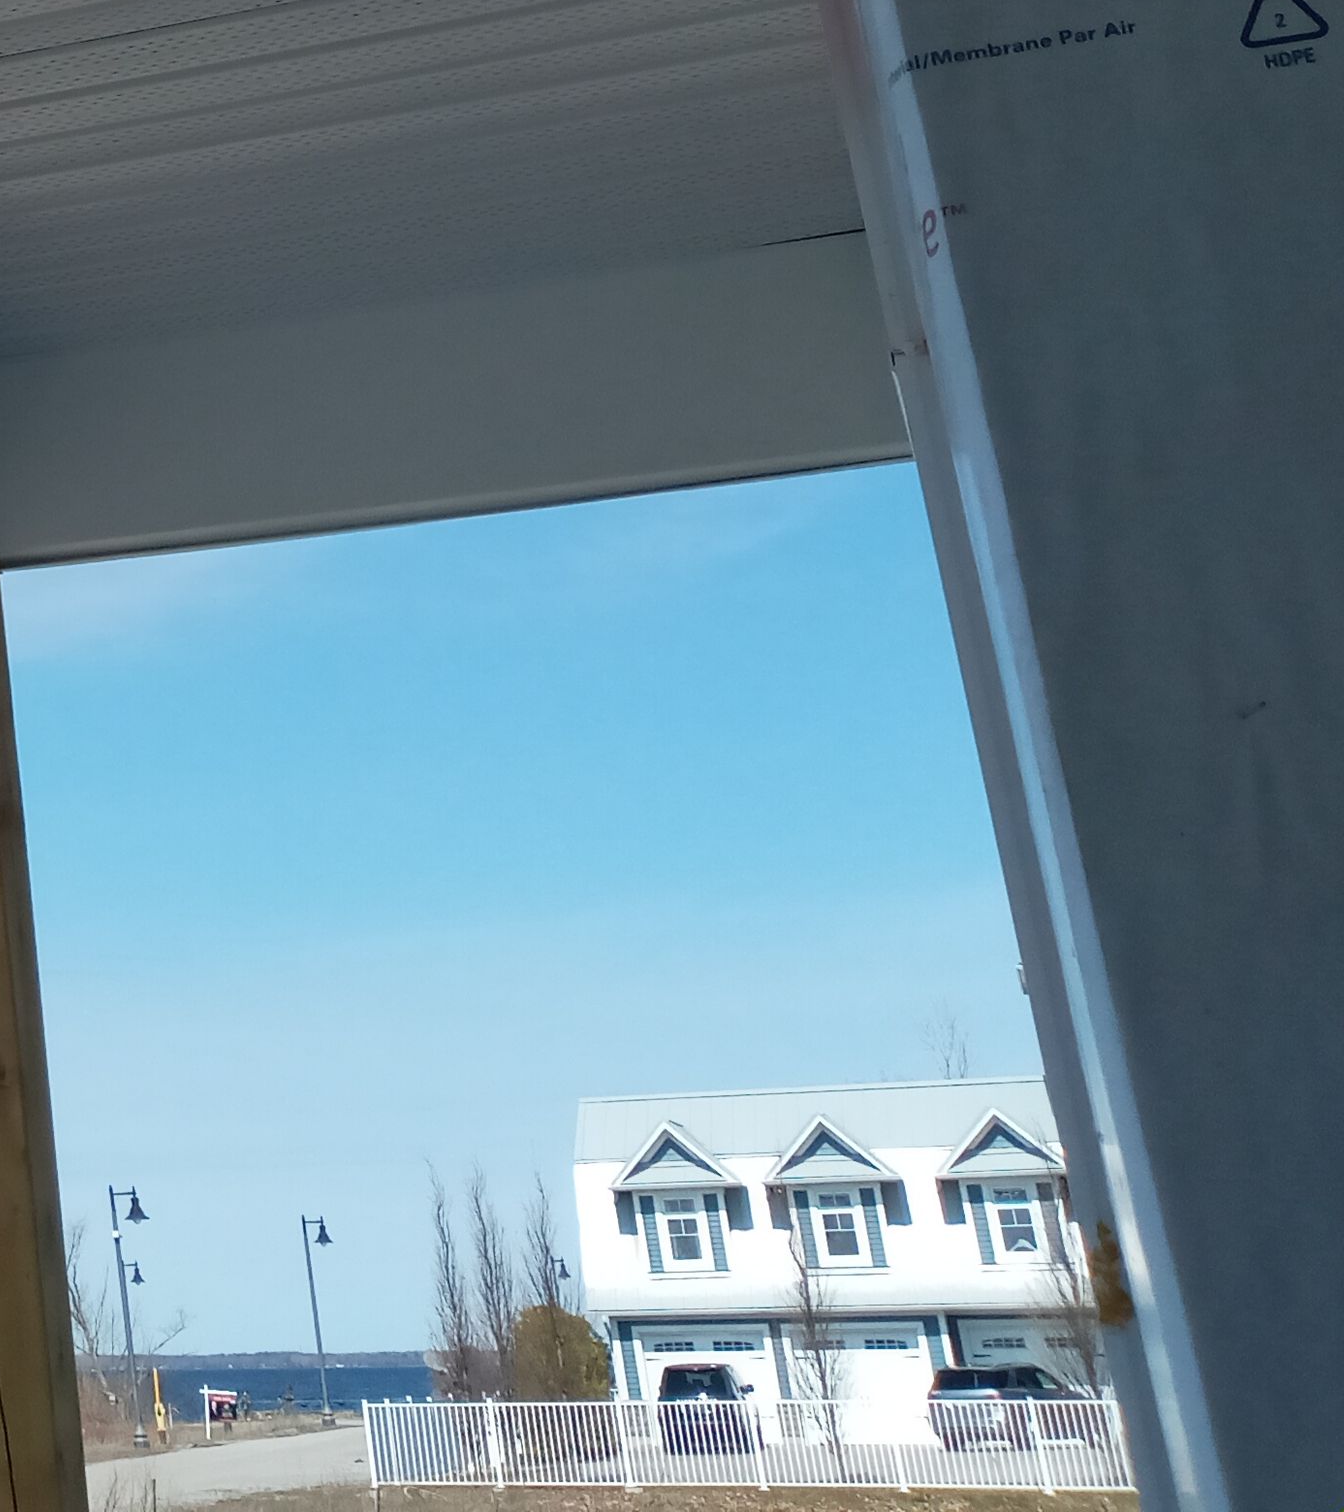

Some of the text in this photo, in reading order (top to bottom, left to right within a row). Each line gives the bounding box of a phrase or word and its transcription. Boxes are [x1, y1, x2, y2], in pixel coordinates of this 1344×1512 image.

[1058, 28, 1096, 45] Par
[1104, 19, 1136, 39] Air
[1273, 12, 1288, 29] 2
[1263, 46, 1317, 69] HDPE
